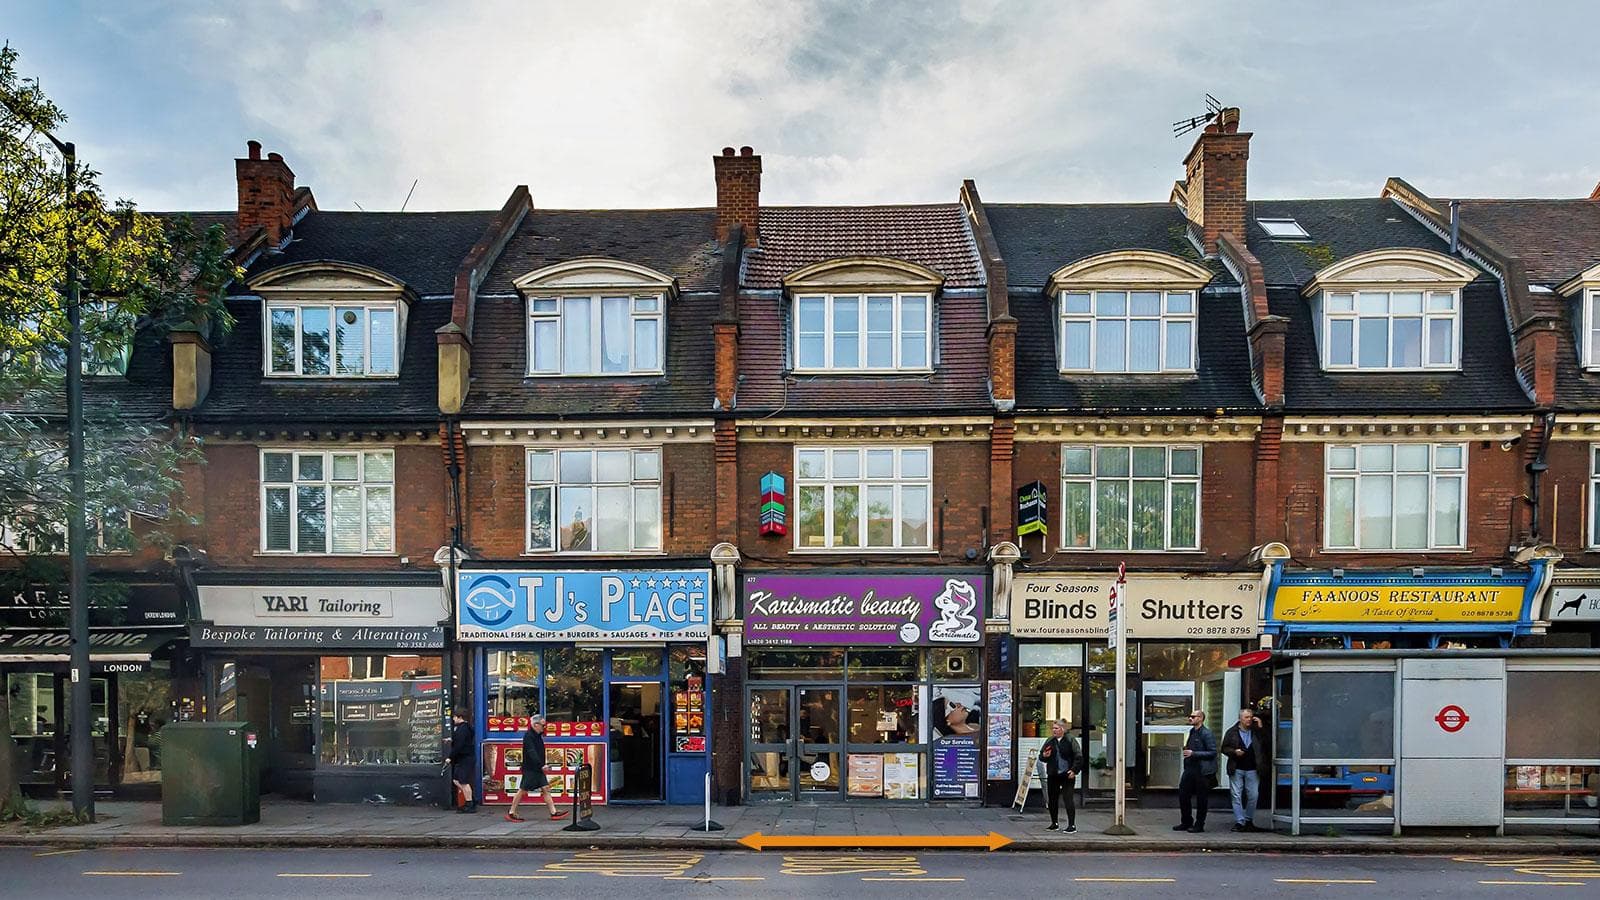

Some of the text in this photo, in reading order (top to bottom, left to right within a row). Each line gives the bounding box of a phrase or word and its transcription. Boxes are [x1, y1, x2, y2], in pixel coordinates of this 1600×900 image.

[1025, 583, 1099, 593] Four Seasons
[1237, 583, 1253, 592] 479
[518, 576, 705, 623] TJ's PLACE
[1302, 590, 1501, 604] FAANOOS RESTAURANT
[262, 596, 381, 615] YARI Tailoring
[750, 591, 920, 622] Karismatic beauty
[1025, 599, 1243, 620] Blinds Shutters
[1361, 608, 1433, 618] A Taste Of Persia
[858, 623, 897, 631] SOLUTION
[1016, 626, 1134, 634] www.fourseasonsblindm
[1187, 626, 1251, 634] 020 8878 8795
[201, 628, 428, 643] Bespoke Tailoring & Alterations
[461, 631, 707, 639] TRADITIONAL FISH & CHIPS BURGERS SAUSAGES PIES ROLLS
[931, 630, 977, 639] Karismatic
[103, 664, 142, 672] LONDON
